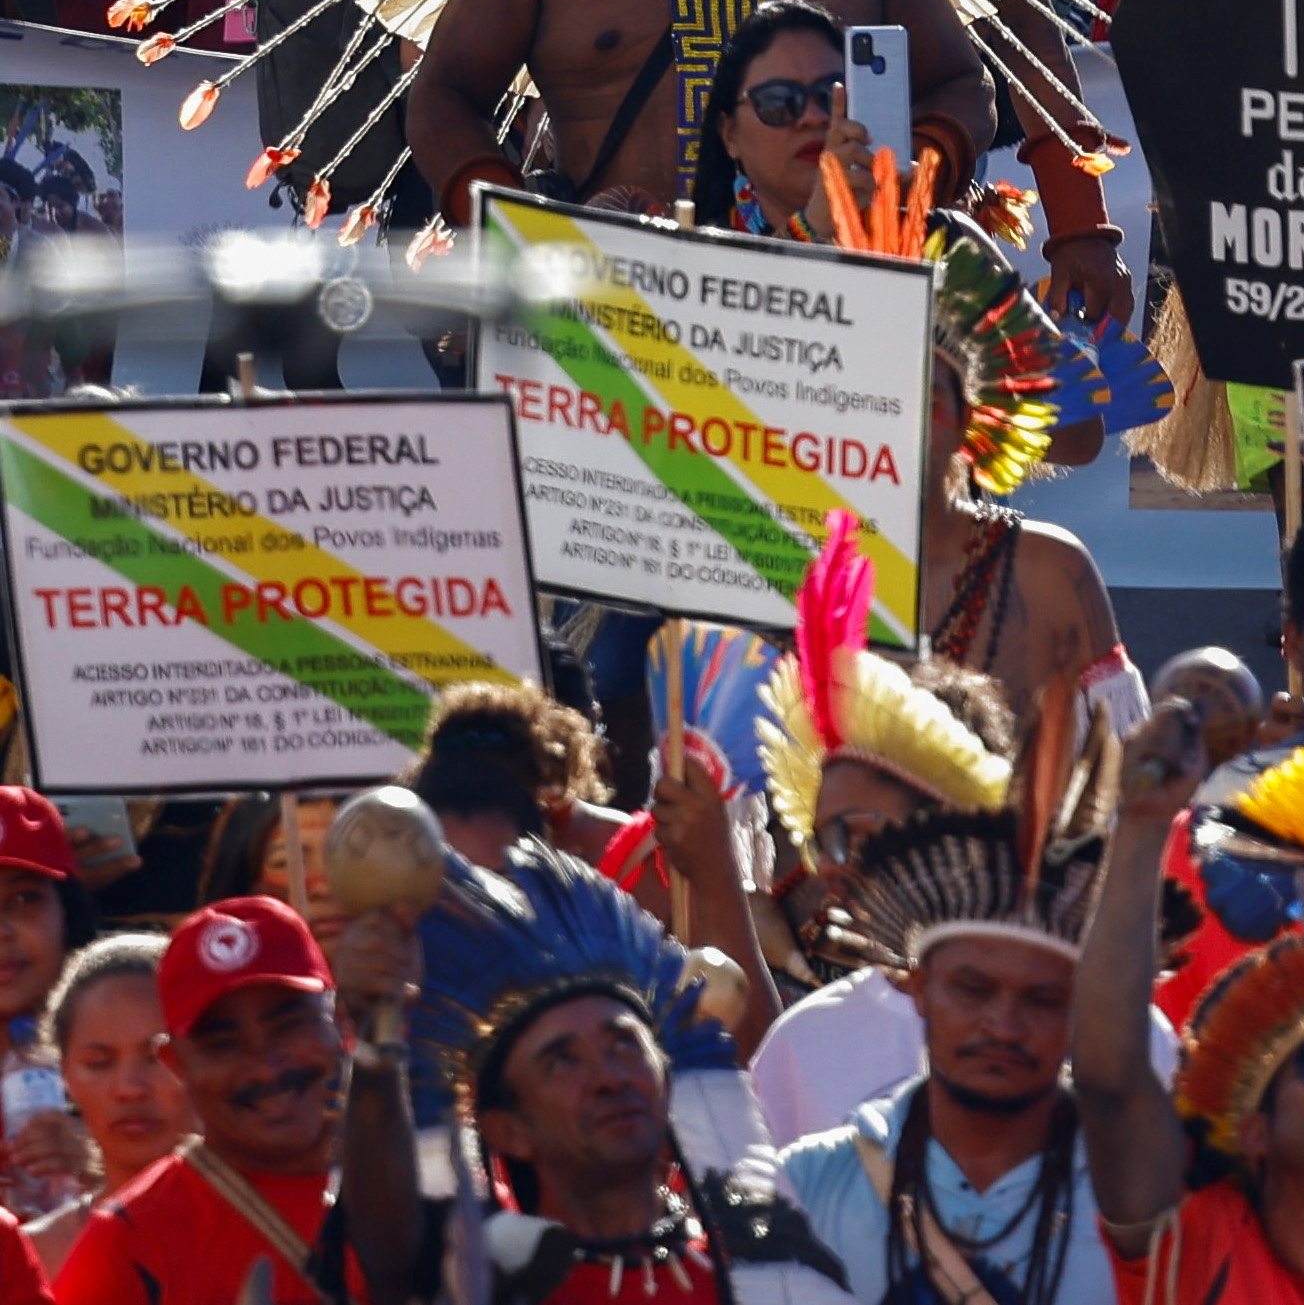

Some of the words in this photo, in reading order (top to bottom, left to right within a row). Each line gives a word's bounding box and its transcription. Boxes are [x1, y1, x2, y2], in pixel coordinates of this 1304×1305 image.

[700, 275, 853, 326] FEDERAL
[550, 300, 681, 343] MINISTÉRIO
[690, 325, 727, 353] DA
[735, 331, 844, 374] JUSTIÇA
[678, 361, 718, 387] dos
[727, 370, 787, 400] Povos
[795, 381, 901, 415] Indígenas
[79, 438, 259, 475] GOVERNO
[272, 435, 439, 468] FEDERAL
[495, 374, 631, 438] TERRA
[642, 408, 901, 485] PROTEGIDA
[91, 486, 257, 521] MINISTÉRIO
[269, 490, 309, 514] DA
[319, 486, 436, 516] JUSTIÇA
[36, 585, 209, 629] TERRA
[221, 578, 512, 625] PROTEGIDA
